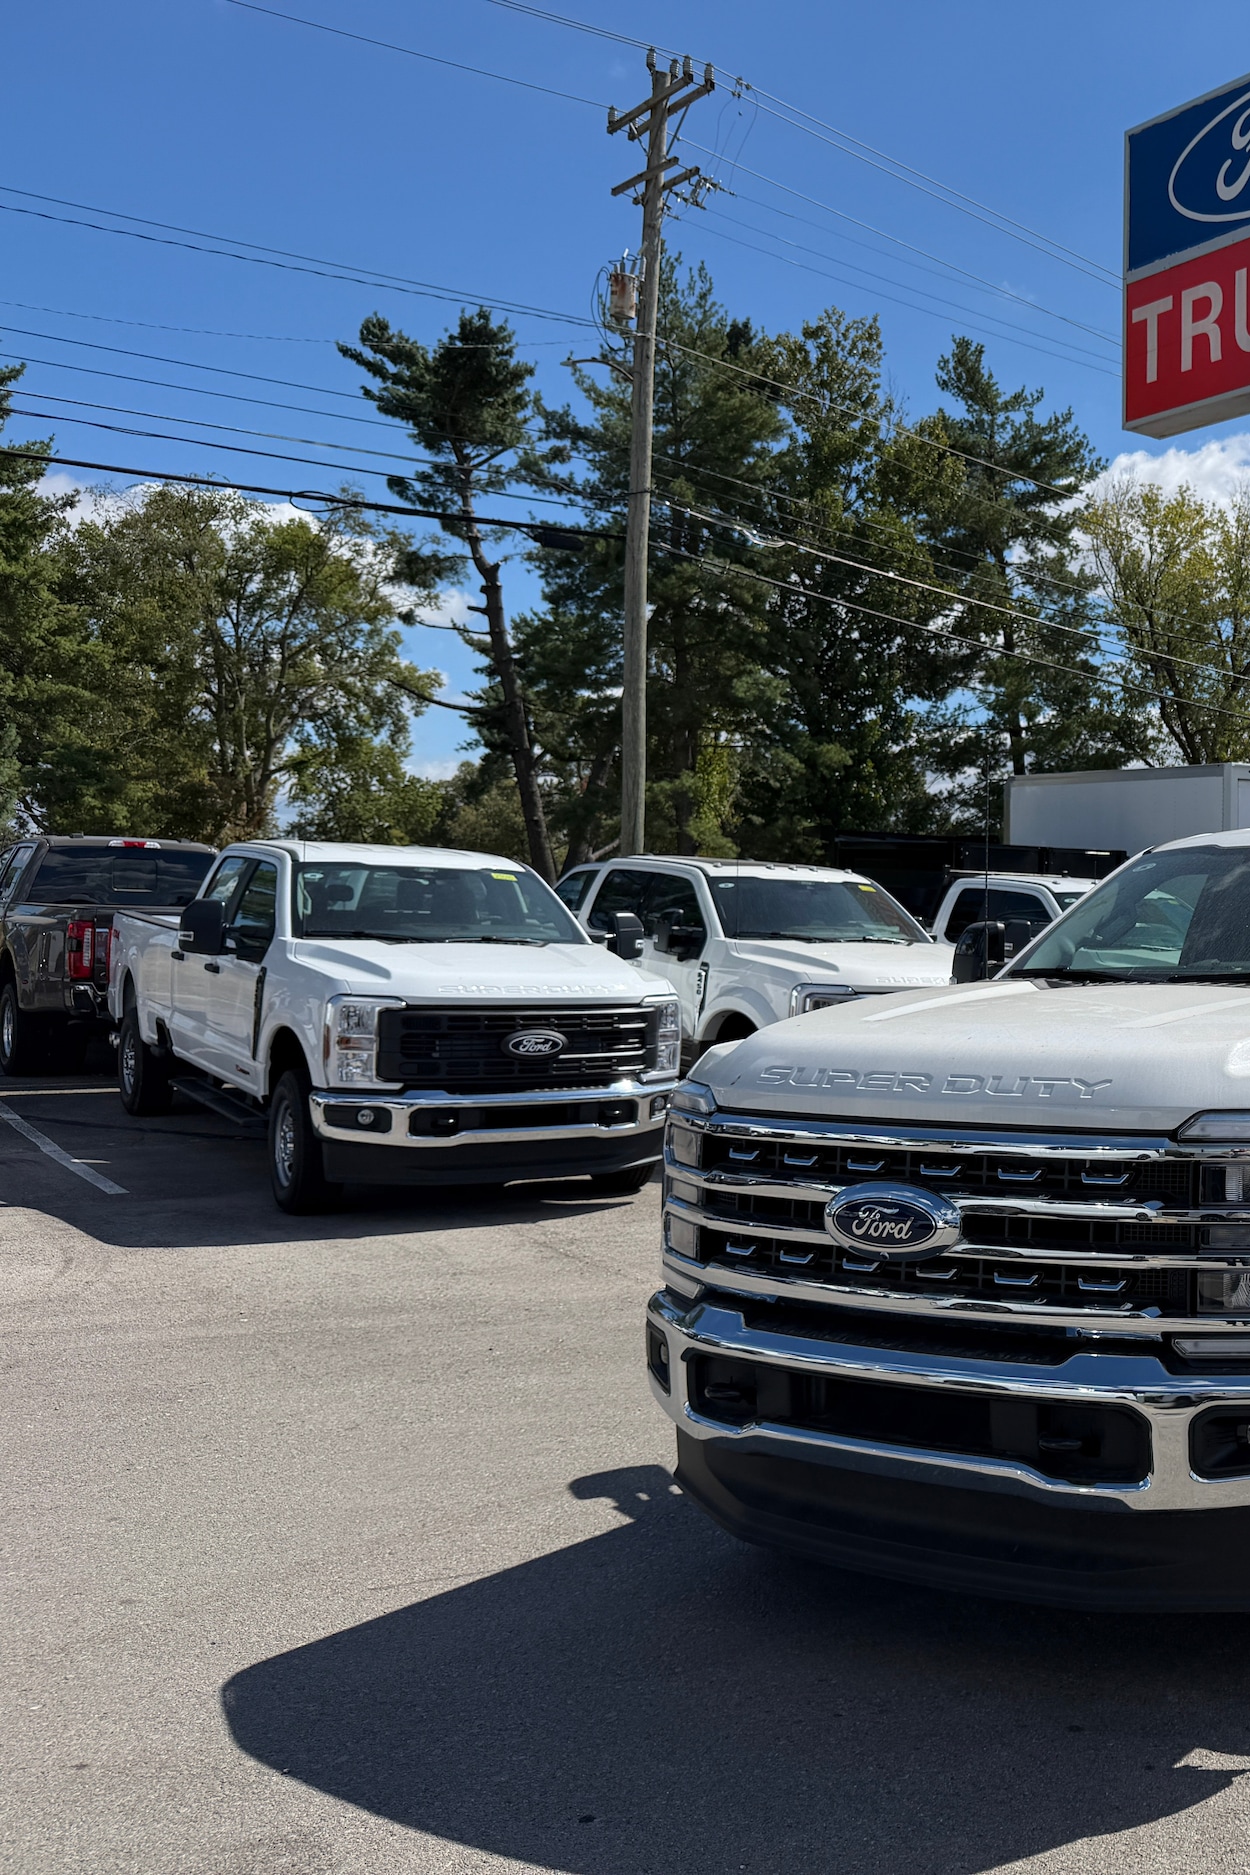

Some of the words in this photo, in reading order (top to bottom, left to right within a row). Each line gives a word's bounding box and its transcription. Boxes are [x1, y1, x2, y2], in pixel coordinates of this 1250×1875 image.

[438, 984, 542, 995] SUPER
[543, 984, 612, 994] DUTY
[518, 1037, 552, 1053] Ford
[756, 1064, 935, 1093] SUPER
[941, 1073, 1113, 1099] DUTY
[851, 1204, 914, 1240] Ford
